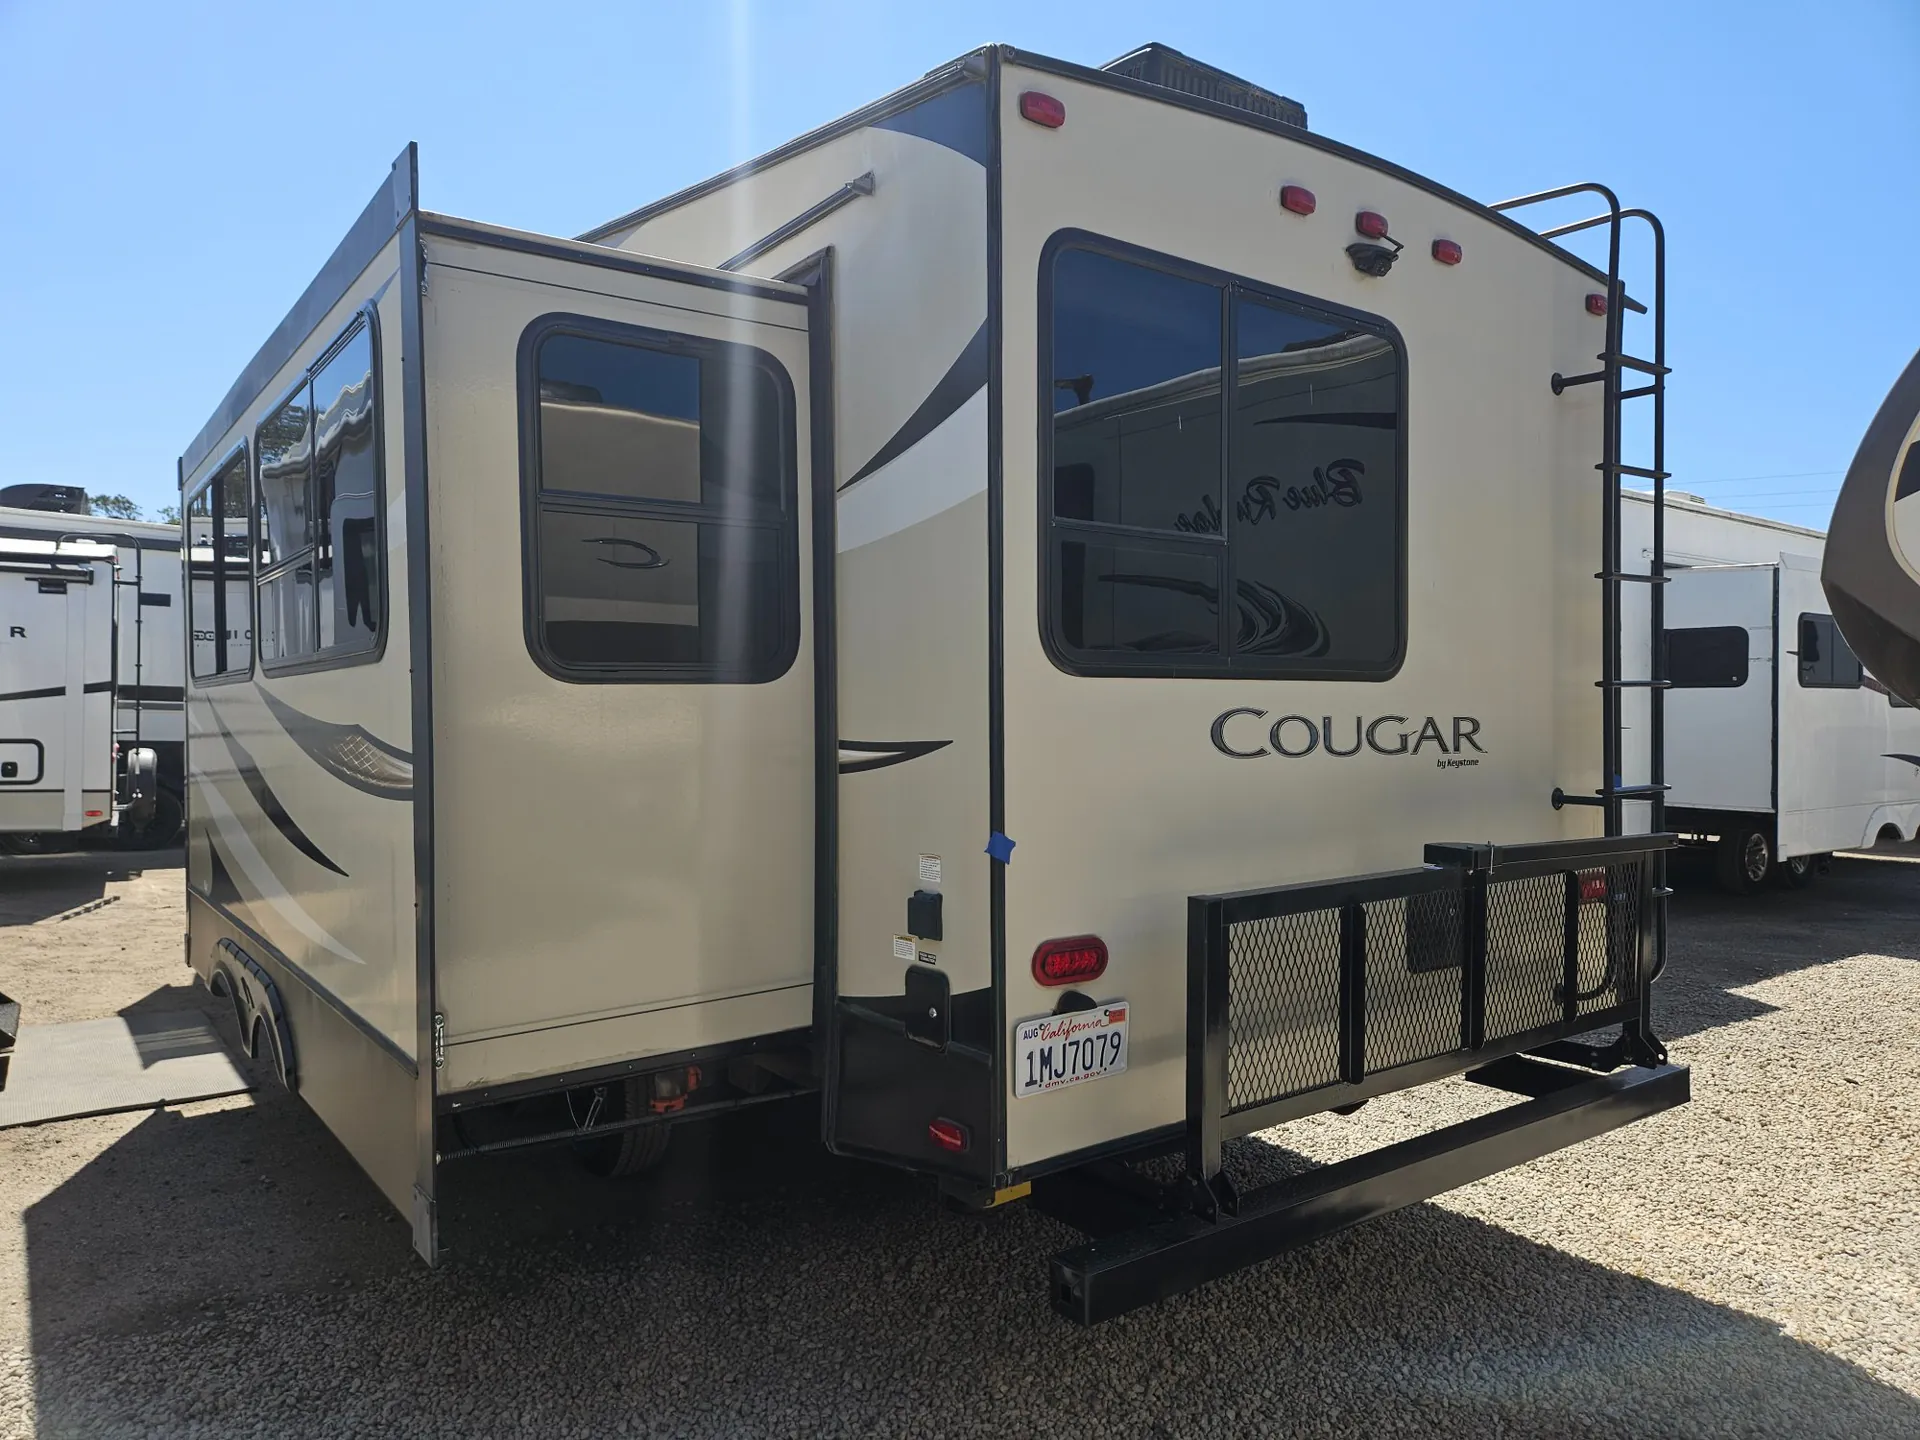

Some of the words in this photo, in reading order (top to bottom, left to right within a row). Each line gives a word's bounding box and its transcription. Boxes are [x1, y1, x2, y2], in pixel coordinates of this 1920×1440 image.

[1210, 707, 1488, 759] COUGAR
[1437, 759, 1446, 769] by
[1447, 759, 1479, 768] Keystone
[1023, 1028, 1039, 1040] AUG
[1040, 1018, 1109, 1042] California
[1024, 1031, 1122, 1088] 1MJ7079
[1045, 1069, 1102, 1089] dmv.ca.gov
